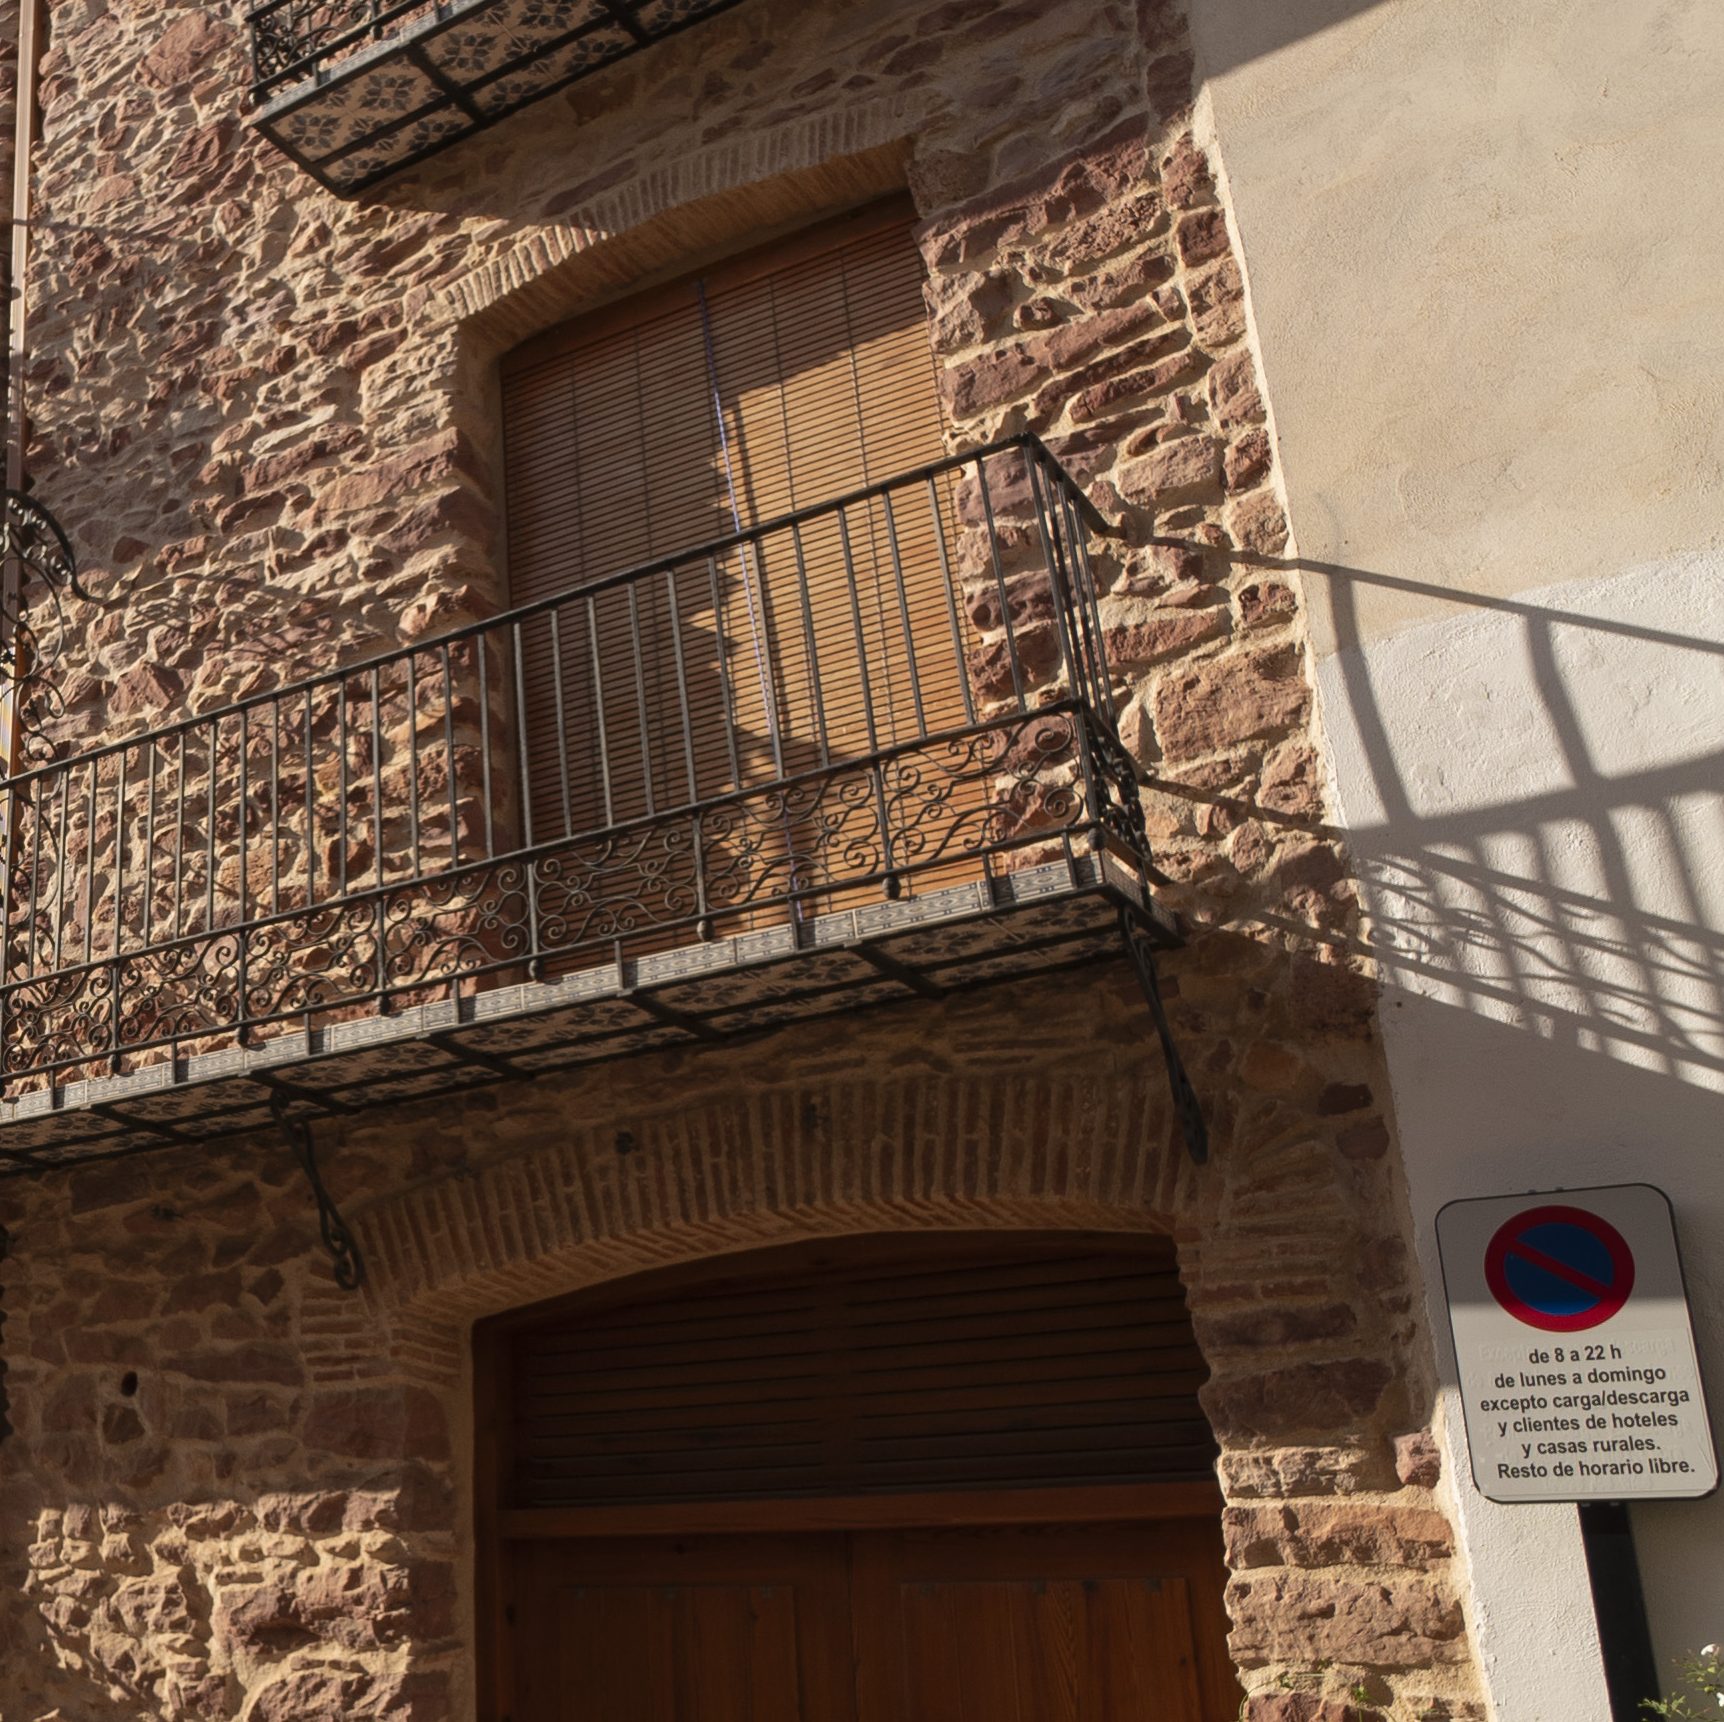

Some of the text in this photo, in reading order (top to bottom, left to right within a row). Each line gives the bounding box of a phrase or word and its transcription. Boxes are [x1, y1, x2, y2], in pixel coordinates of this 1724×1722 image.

[1529, 1349, 1549, 1364] de
[1554, 1347, 1565, 1363] 8
[1570, 1349, 1580, 1362] a
[1584, 1345, 1606, 1361] 22
[1610, 1344, 1622, 1359] h
[1494, 1366, 1666, 1389] de lunes a domingo
[1480, 1389, 1690, 1413] excepto carga/descarga
[1498, 1411, 1678, 1437] y clientes de hoteles
[1521, 1436, 1661, 1459] y casas rurales.
[1497, 1457, 1695, 1479] Resto de horario libre.
